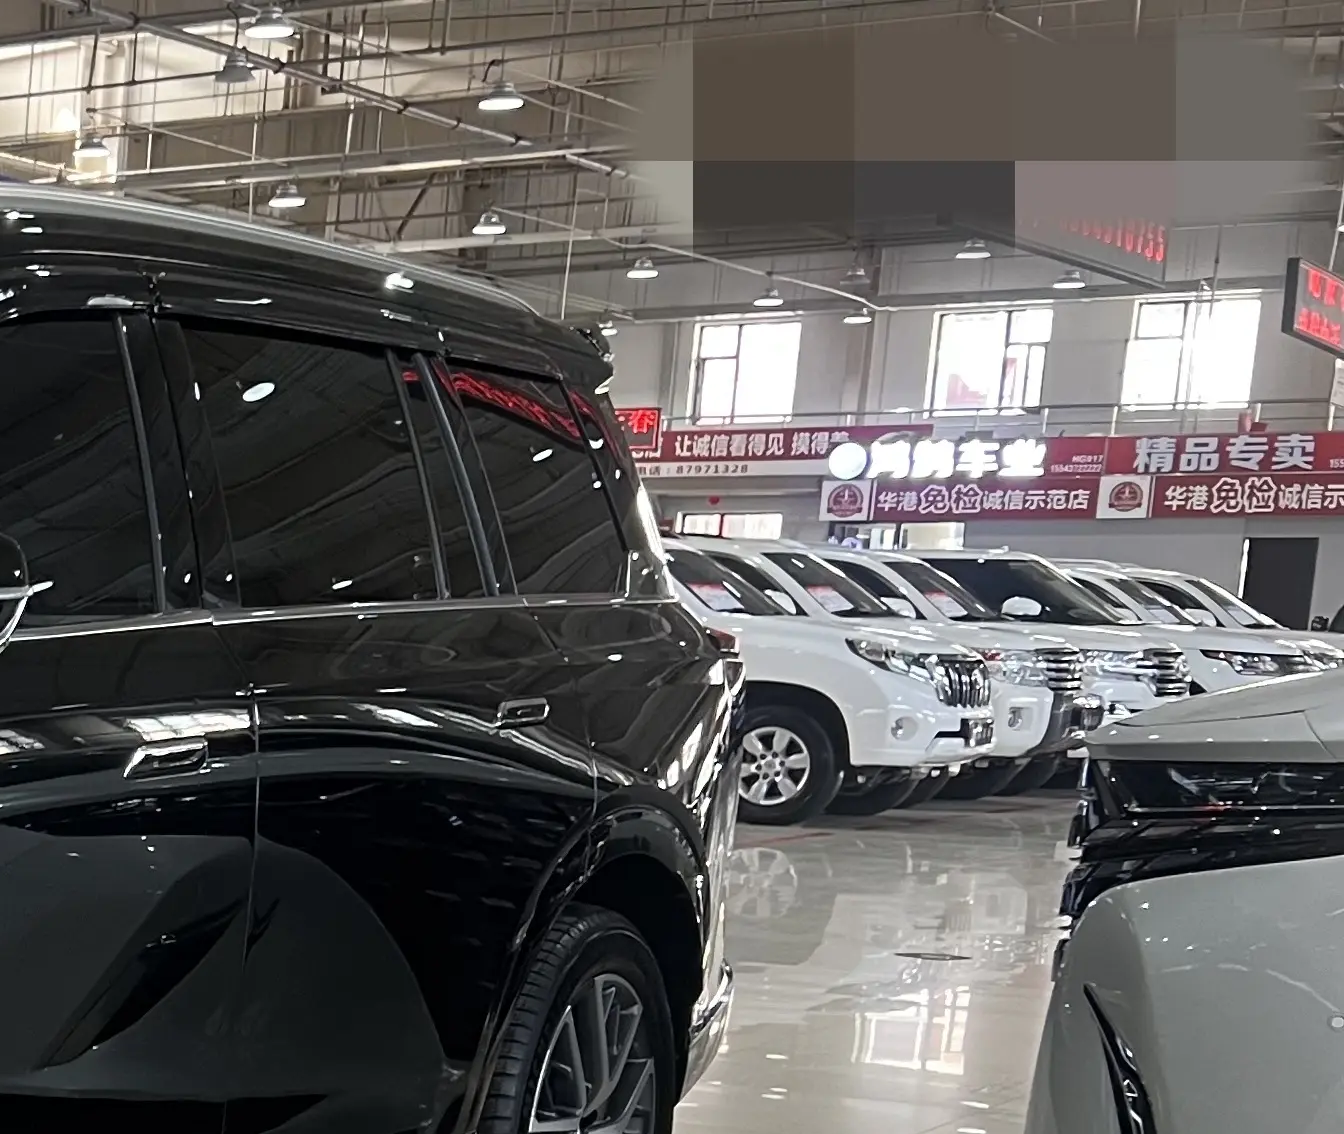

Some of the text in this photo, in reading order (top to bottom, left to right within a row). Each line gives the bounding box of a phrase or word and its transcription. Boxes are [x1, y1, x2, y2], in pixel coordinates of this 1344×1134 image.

[676, 432, 783, 458] 让诚信看得见
[1134, 433, 1315, 472] 精品专卖
[676, 465, 749, 475] 87971328
[877, 485, 1091, 515] 华港免检诚信示范店
